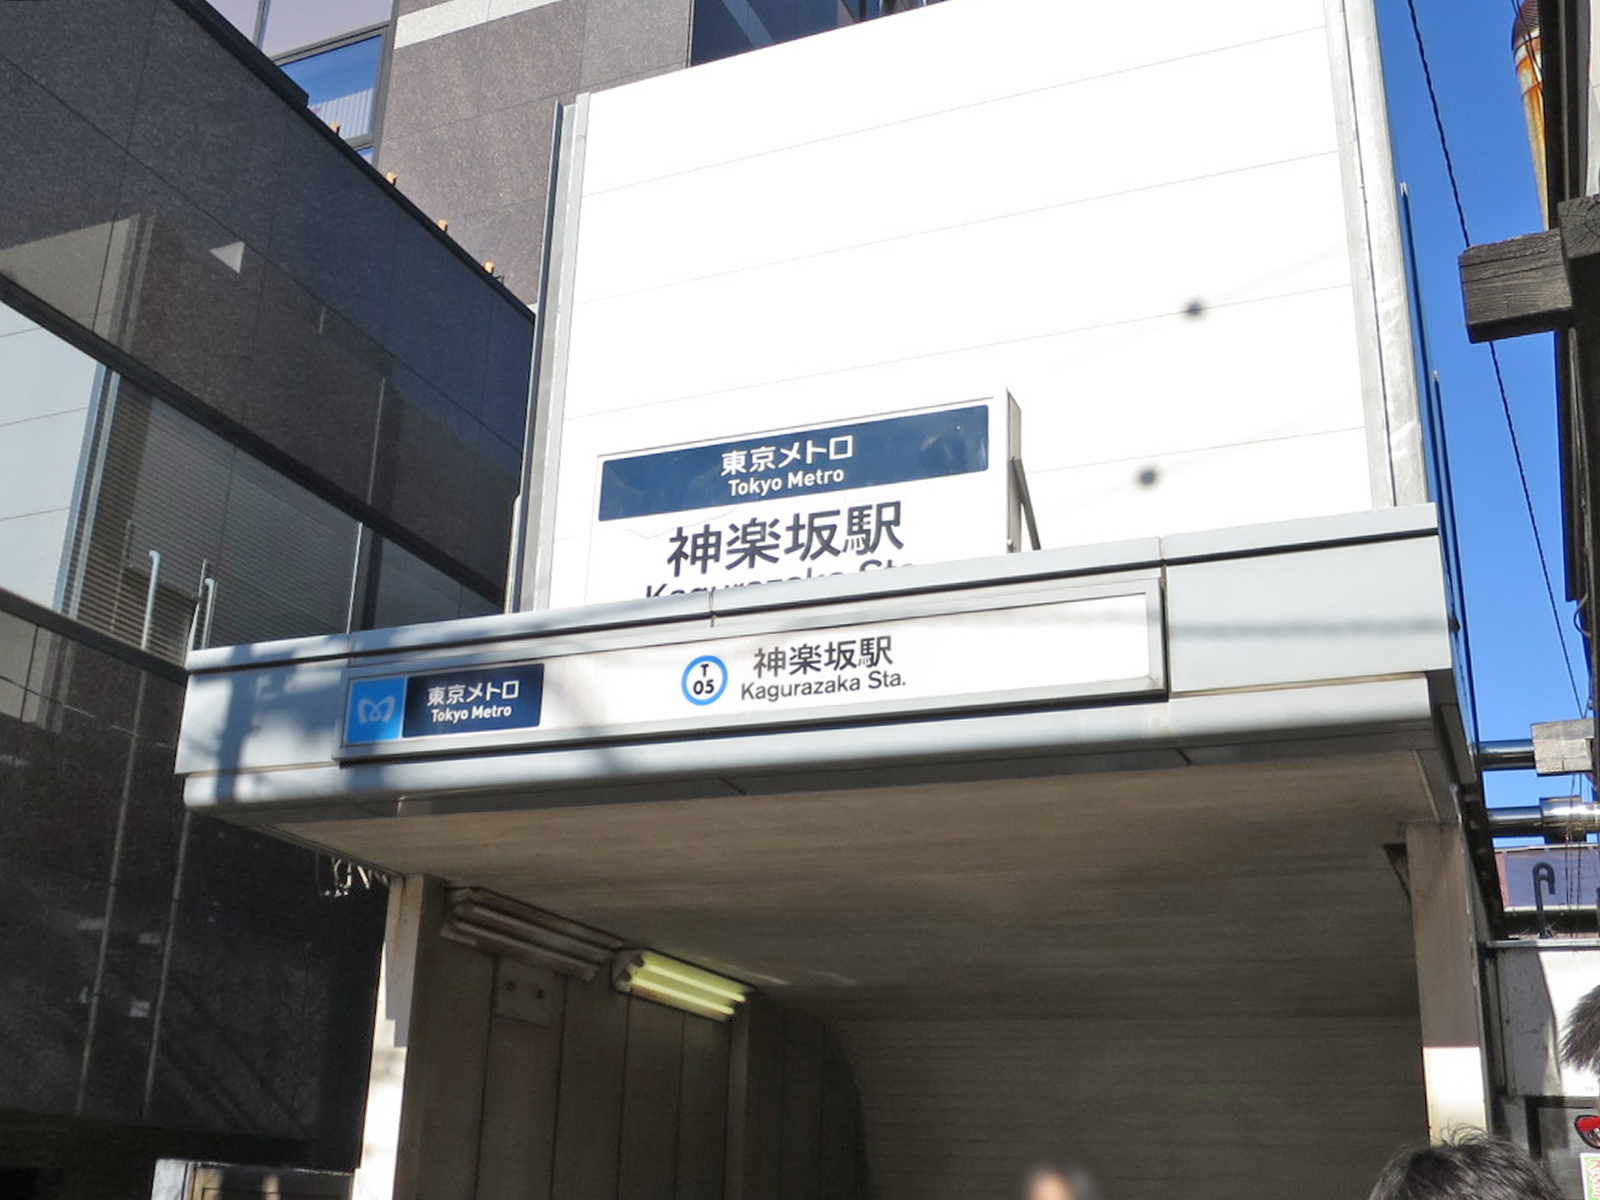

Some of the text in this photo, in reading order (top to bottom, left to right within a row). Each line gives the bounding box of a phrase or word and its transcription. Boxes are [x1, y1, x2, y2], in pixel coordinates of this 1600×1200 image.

[721, 435, 853, 476] 東京メトロ
[728, 469, 844, 496] Tokyo Metro
[667, 500, 904, 577] 神楽坂駅
[700, 663, 709, 677] T
[753, 635, 893, 679] 神楽坂駅
[427, 680, 519, 706] 東京メトロ
[693, 679, 715, 696] 05
[741, 670, 906, 702] Kagurazaka Sta.
[431, 705, 512, 724] Tokyo Metro
